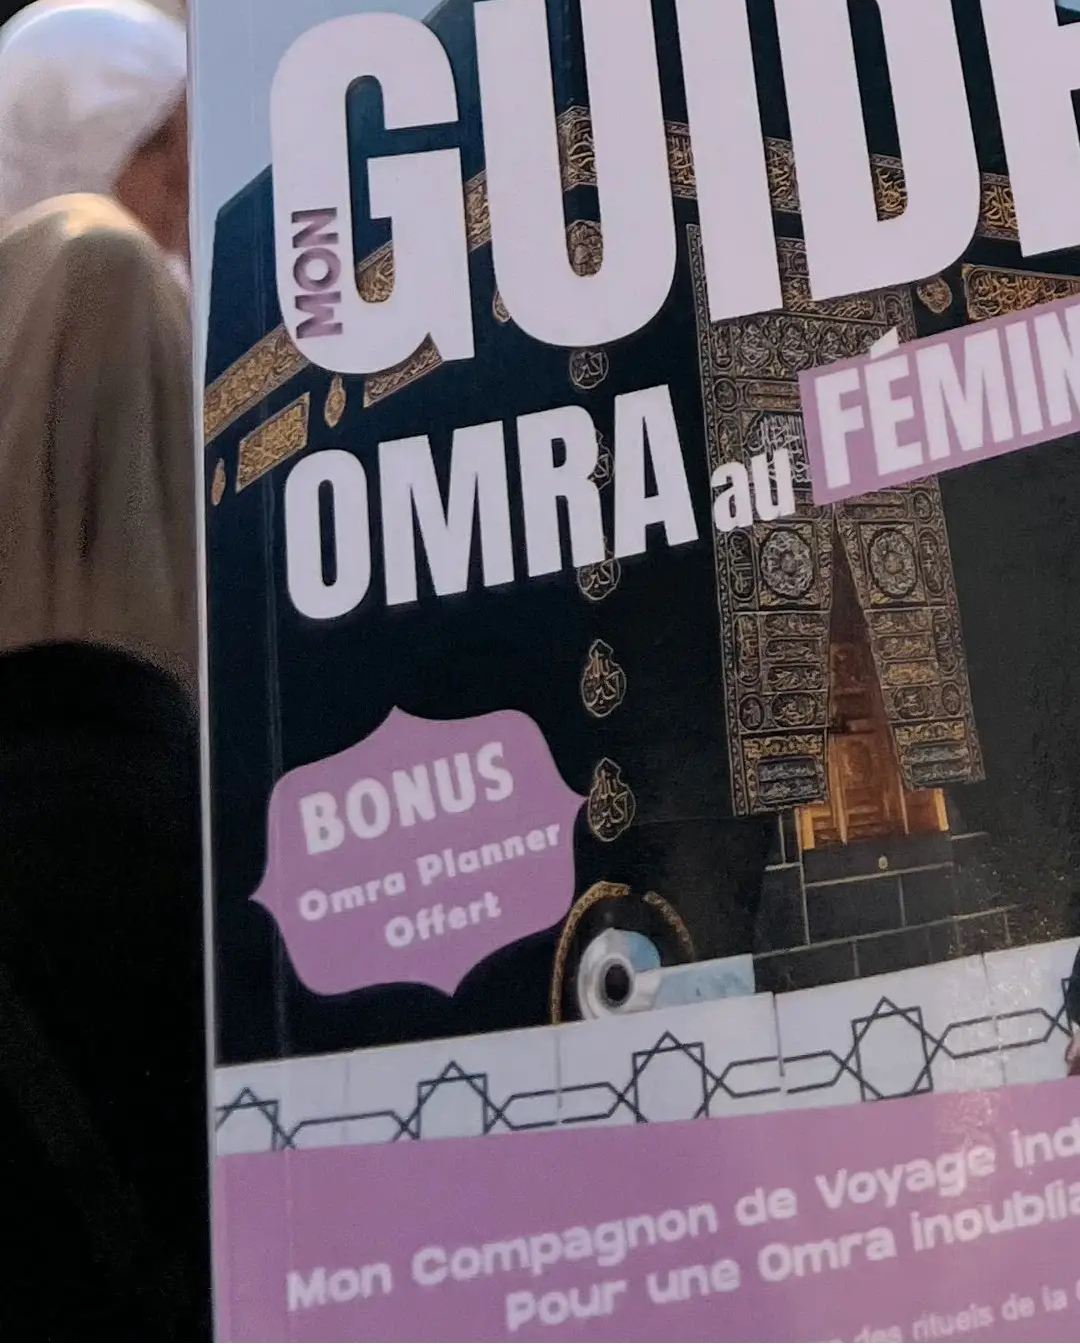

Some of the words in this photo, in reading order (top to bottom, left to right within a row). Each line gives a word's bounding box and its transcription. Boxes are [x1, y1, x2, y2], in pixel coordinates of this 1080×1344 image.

[291, 207, 344, 339] MON
[281, 384, 699, 620] OMRA
[711, 447, 797, 532] au
[299, 741, 514, 855] BONUS
[298, 872, 406, 922] Omra
[416, 823, 561, 886] Planner
[384, 891, 502, 948] Offert
[287, 1261, 393, 1311] Mon
[411, 1202, 718, 1286] Compagnon
[735, 1186, 797, 1227] de
[814, 1144, 997, 1210] Voyage
[504, 1277, 628, 1332] Pour
[646, 1257, 741, 1304] une
[757, 1225, 899, 1283] Omra
[911, 1302, 996, 1342] rituels
[1001, 1292, 1036, 1322] de
[1041, 1285, 1069, 1312] la
